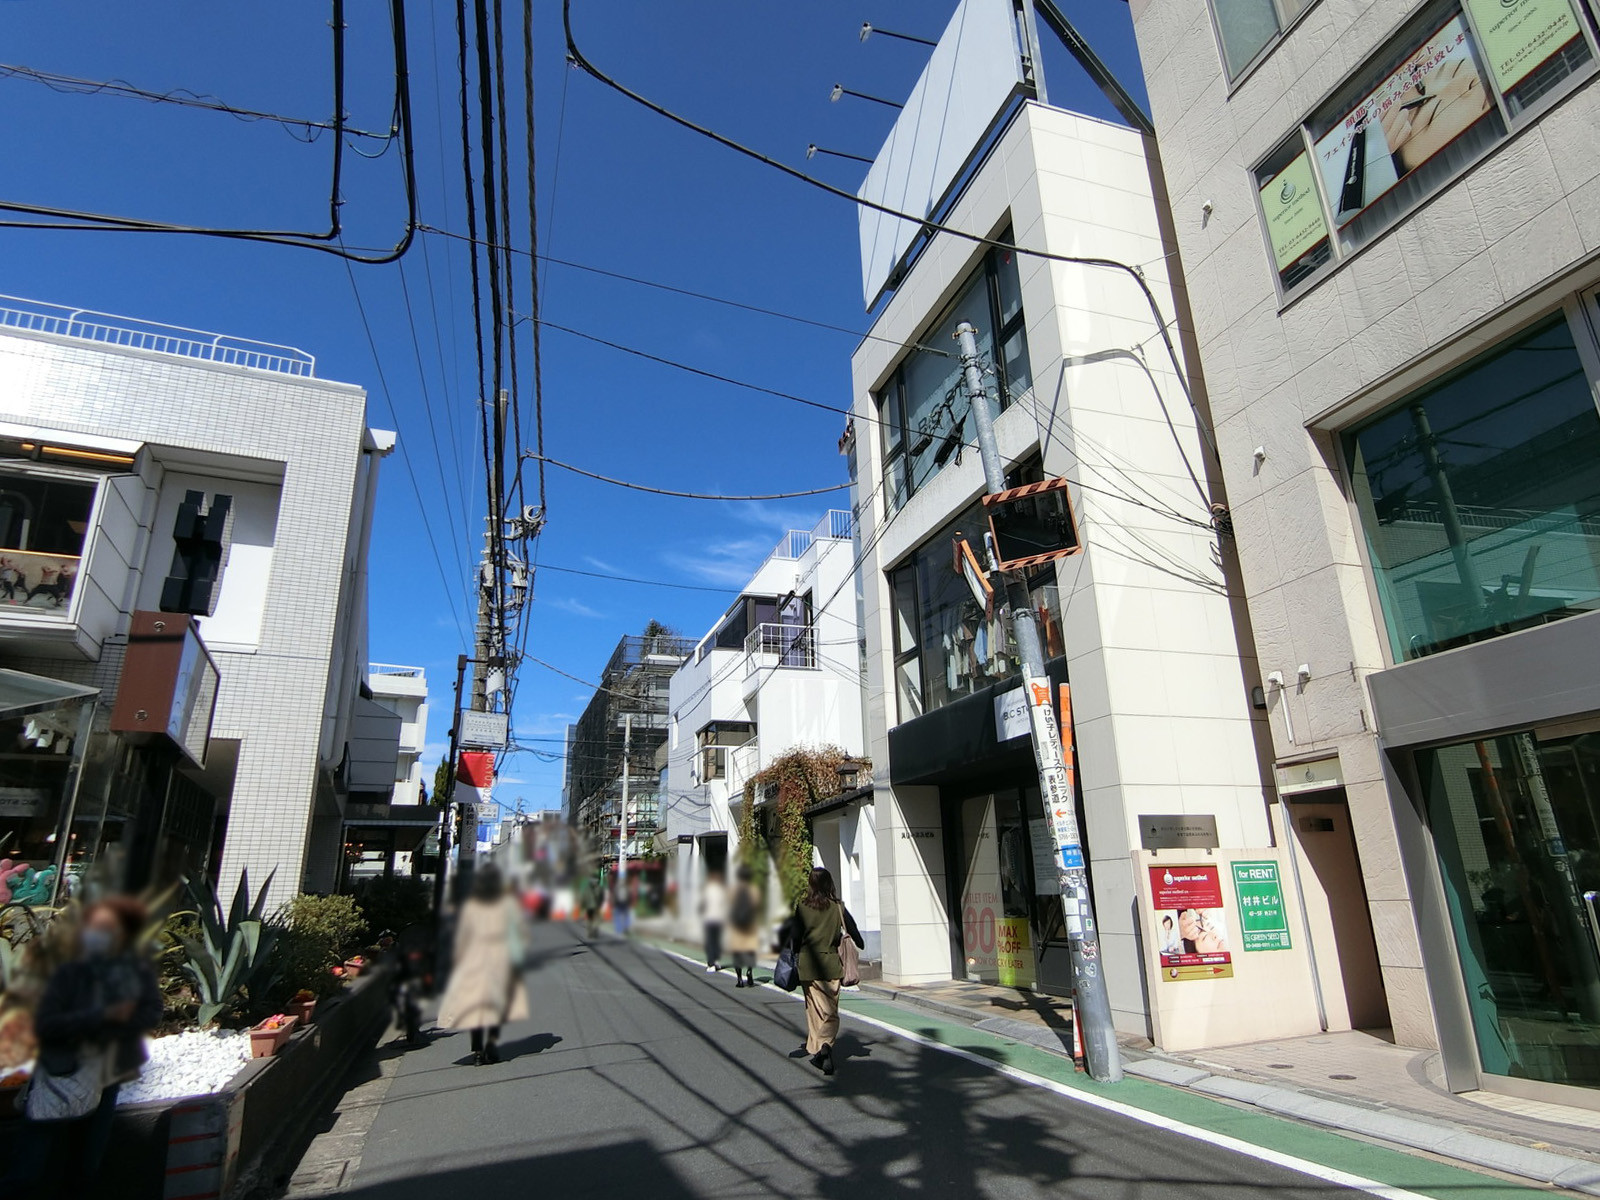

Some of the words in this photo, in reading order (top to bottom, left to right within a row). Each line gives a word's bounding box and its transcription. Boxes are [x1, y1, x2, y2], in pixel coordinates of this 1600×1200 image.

[1345, 45, 1435, 129] 顔筋コーディネート
[1043, 709, 1068, 803] けい子レディースクリニック
[1048, 774, 1060, 804] 表参道
[1238, 870, 1248, 878] for
[1249, 868, 1273, 879] RENT
[1242, 895, 1279, 907] 村井ビル
[963, 906, 996, 954] 80
[998, 925, 1018, 938] MAX
